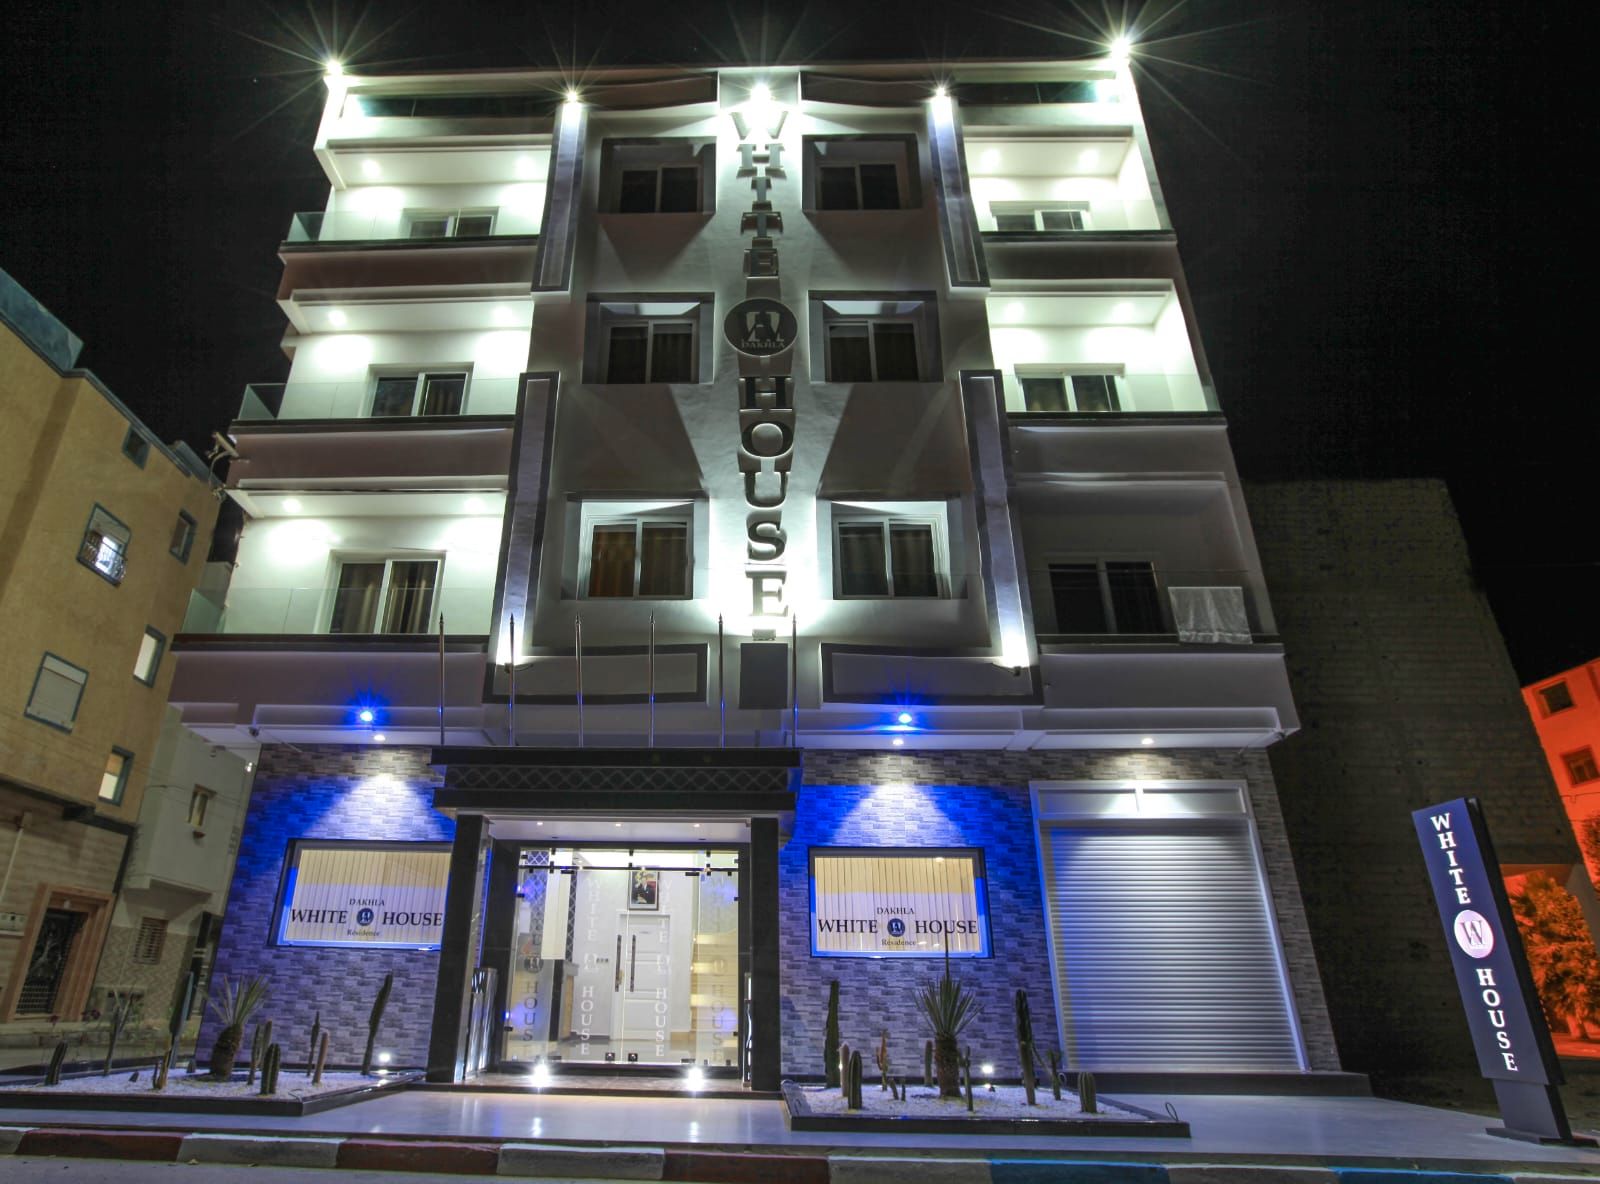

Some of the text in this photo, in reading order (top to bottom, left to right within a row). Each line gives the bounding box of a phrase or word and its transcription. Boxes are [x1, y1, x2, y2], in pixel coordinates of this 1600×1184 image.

[739, 376, 794, 617] HOUSE
[291, 908, 443, 927] WHITE HOUSE
[349, 898, 385, 907] DAKHLA
[876, 907, 915, 915] DAKHLA
[818, 919, 978, 934] WHITE HOUSE
[1430, 812, 1519, 1072] WHITE HOUSE
[581, 985, 593, 1056] HOUSE
[654, 987, 668, 1057] HOUSE
